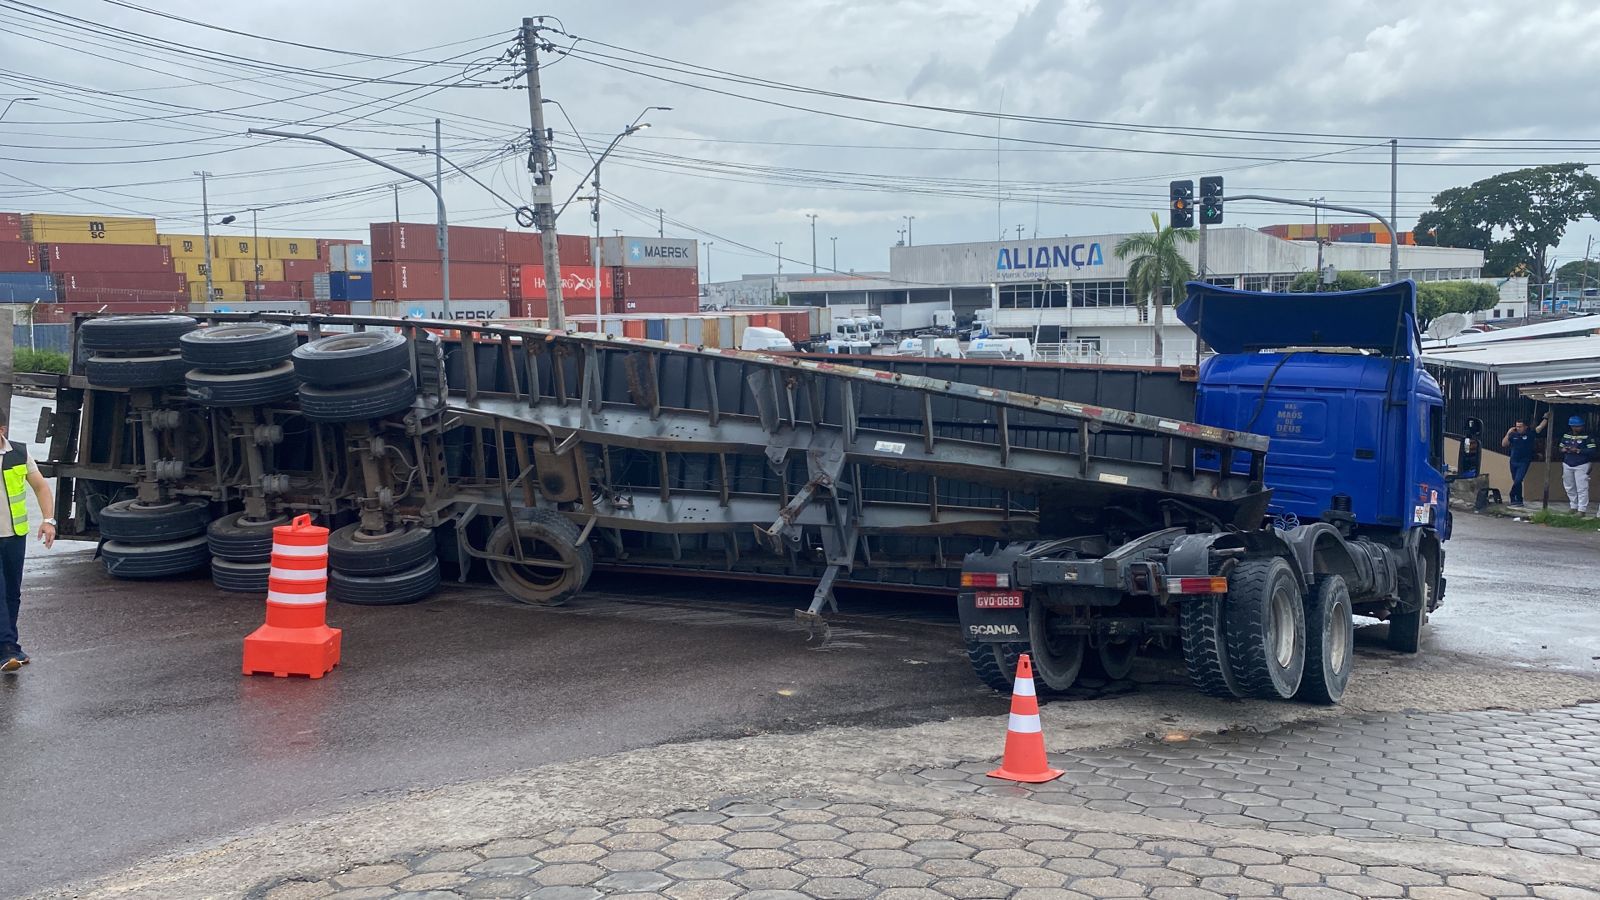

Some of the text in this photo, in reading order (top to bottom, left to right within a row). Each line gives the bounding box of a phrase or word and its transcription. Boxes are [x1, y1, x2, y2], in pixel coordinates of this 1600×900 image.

[644, 245, 689, 258] MAERSK
[997, 243, 1103, 270] ALIANÇA
[969, 625, 1019, 635] SCANIA
